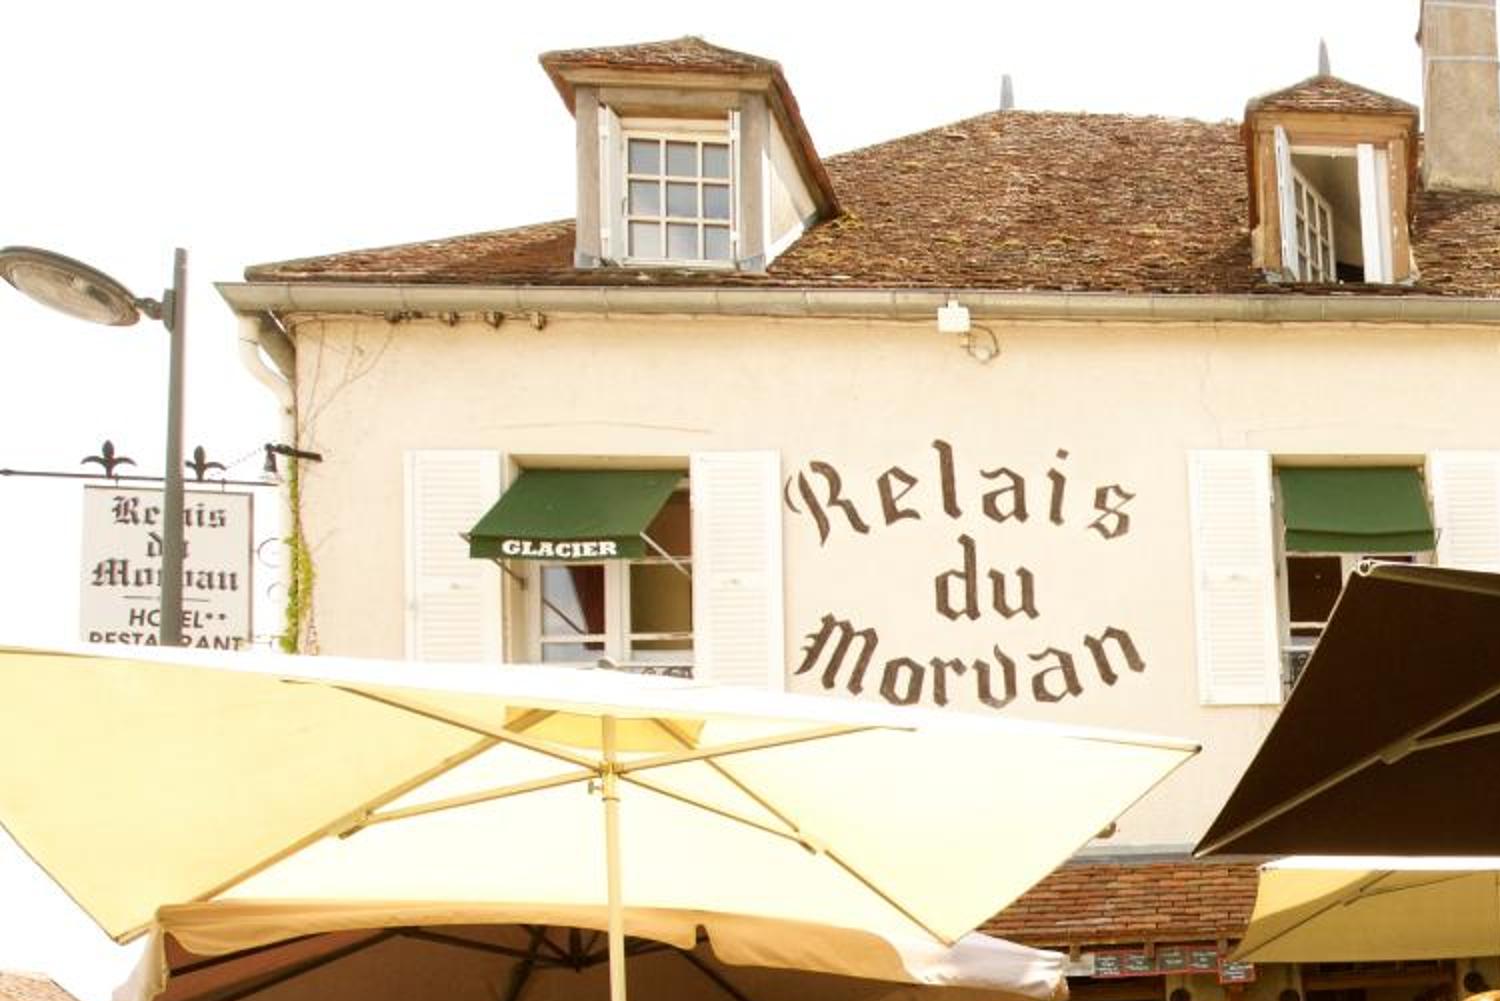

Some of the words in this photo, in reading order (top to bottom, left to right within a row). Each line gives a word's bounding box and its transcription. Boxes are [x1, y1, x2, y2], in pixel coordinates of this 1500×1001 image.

[784, 438, 1135, 548] Relais
[112, 496, 227, 527] Reis
[501, 539, 617, 558] GLACIER
[91, 558, 238, 591] Moan
[935, 533, 1040, 621] du
[89, 631, 244, 651] RESTARANT
[794, 612, 1146, 709] Morvan
